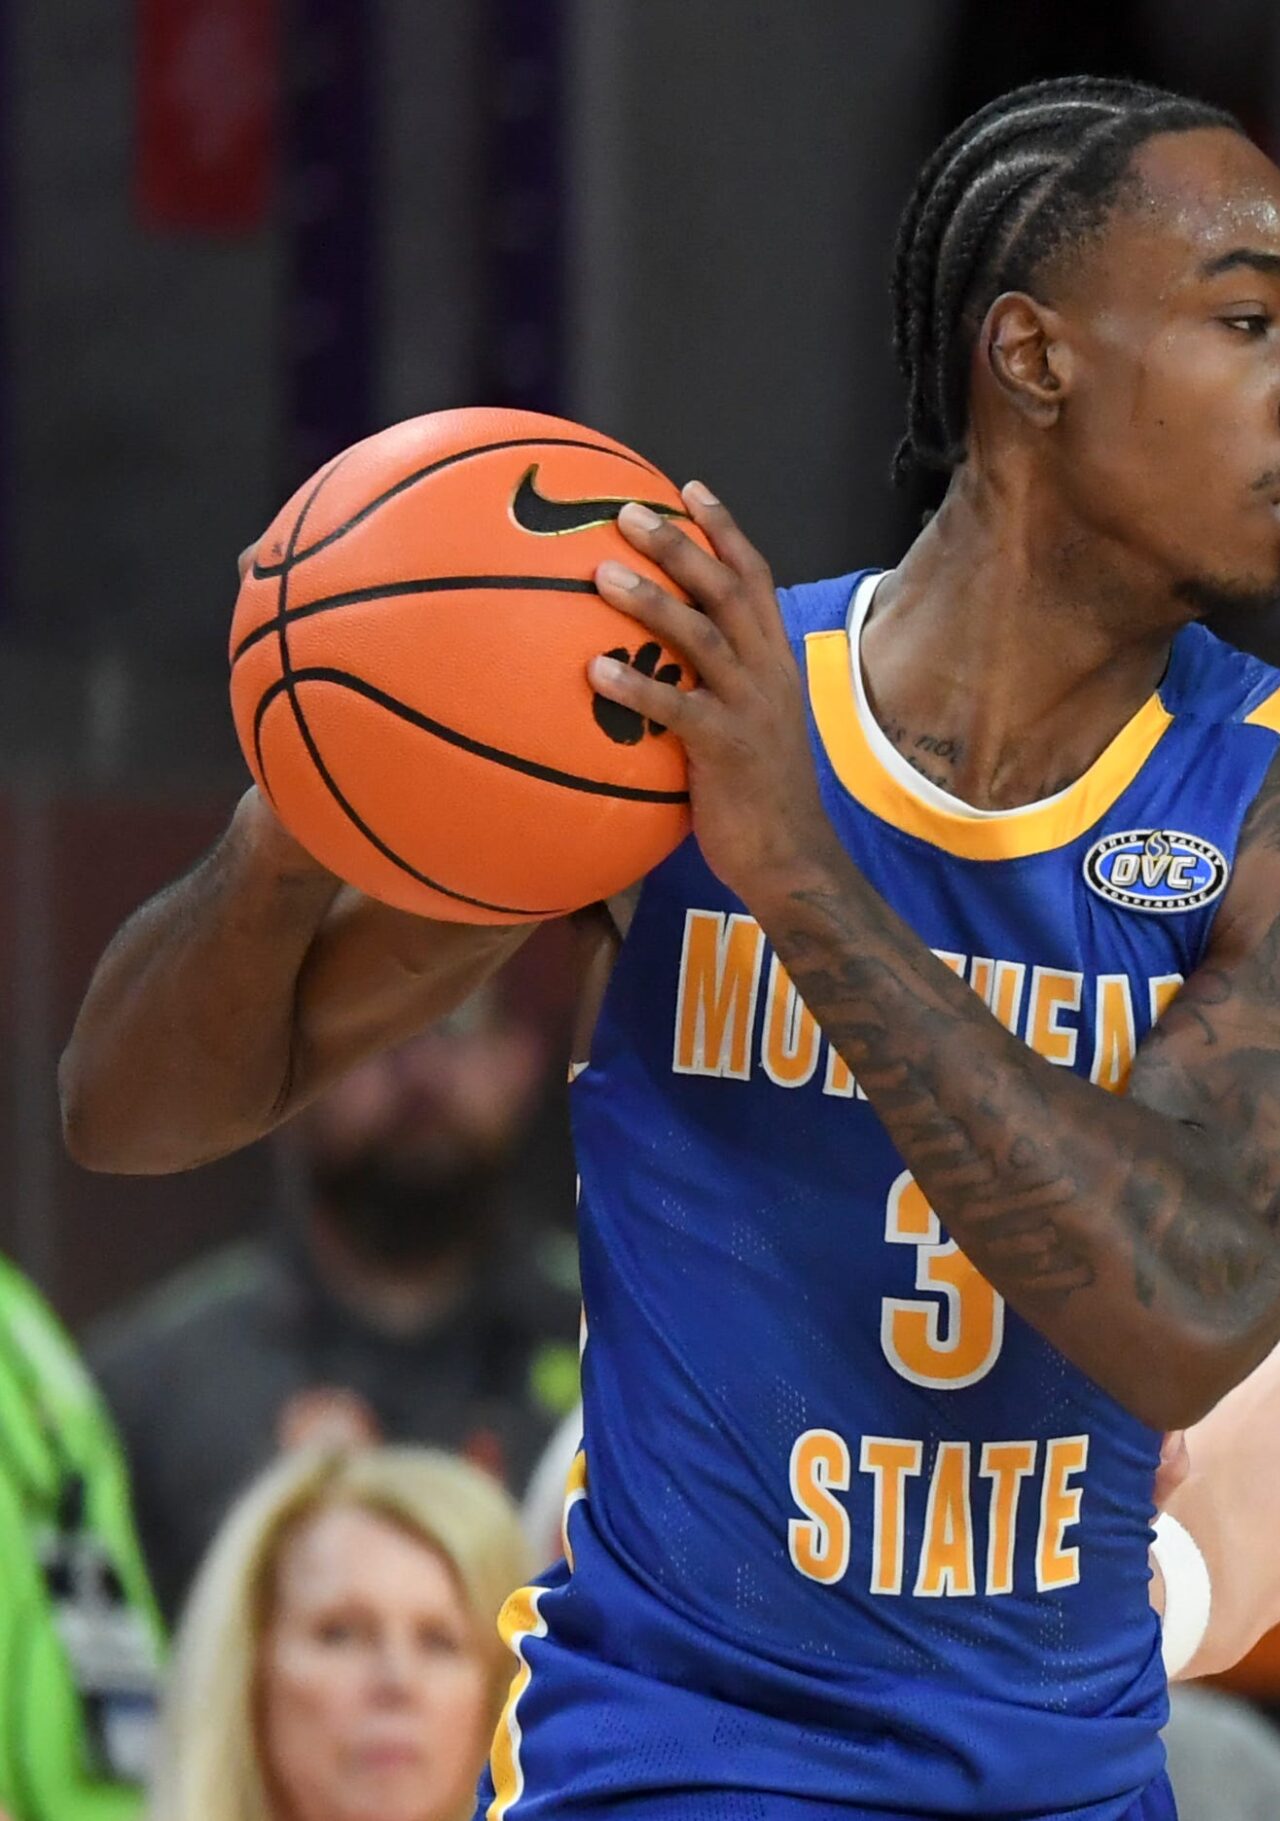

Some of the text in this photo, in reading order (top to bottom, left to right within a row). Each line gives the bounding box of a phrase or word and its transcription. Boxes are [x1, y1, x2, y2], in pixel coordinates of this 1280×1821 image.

[1098, 834, 1222, 865] OHIO VALLEY
[1110, 853, 1196, 890] OVC
[673, 909, 1184, 1100] MOEA
[881, 1169, 1004, 1390] 3
[788, 1429, 1089, 1597] STATE
